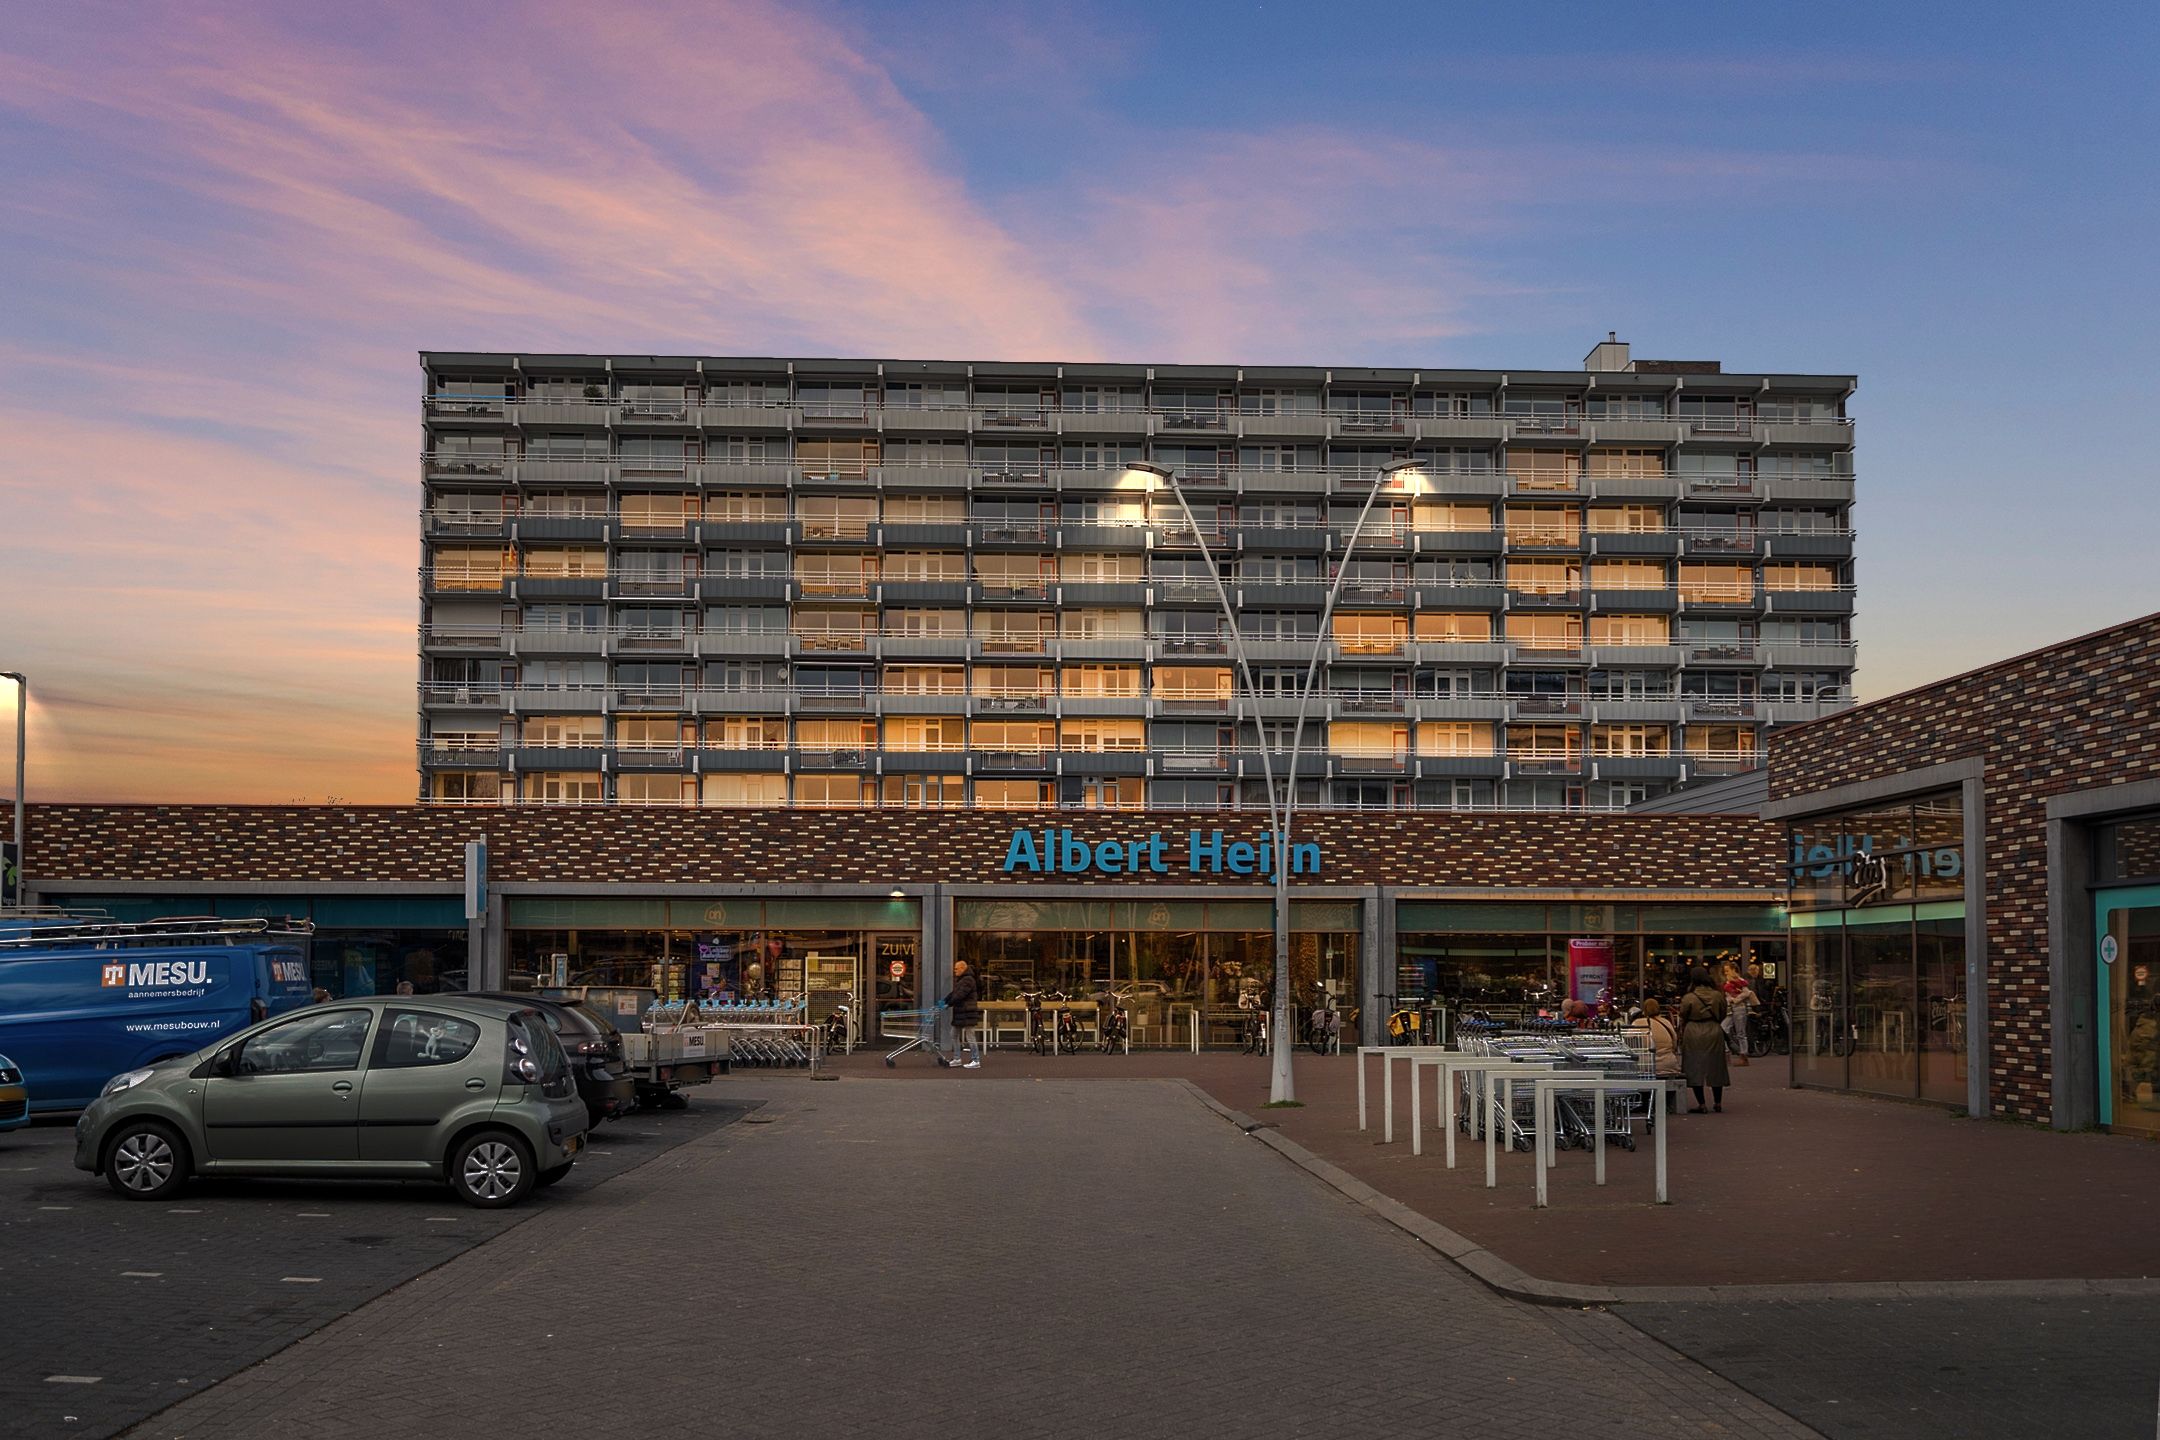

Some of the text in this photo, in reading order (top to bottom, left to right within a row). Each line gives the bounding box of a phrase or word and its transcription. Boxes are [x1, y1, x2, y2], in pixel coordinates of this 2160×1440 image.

[1003, 829, 1169, 873] Albert
[128, 961, 212, 986] MESU.
[128, 988, 205, 998] aannemersbedrijf
[126, 1020, 220, 1032] www.mesubouw.nl
